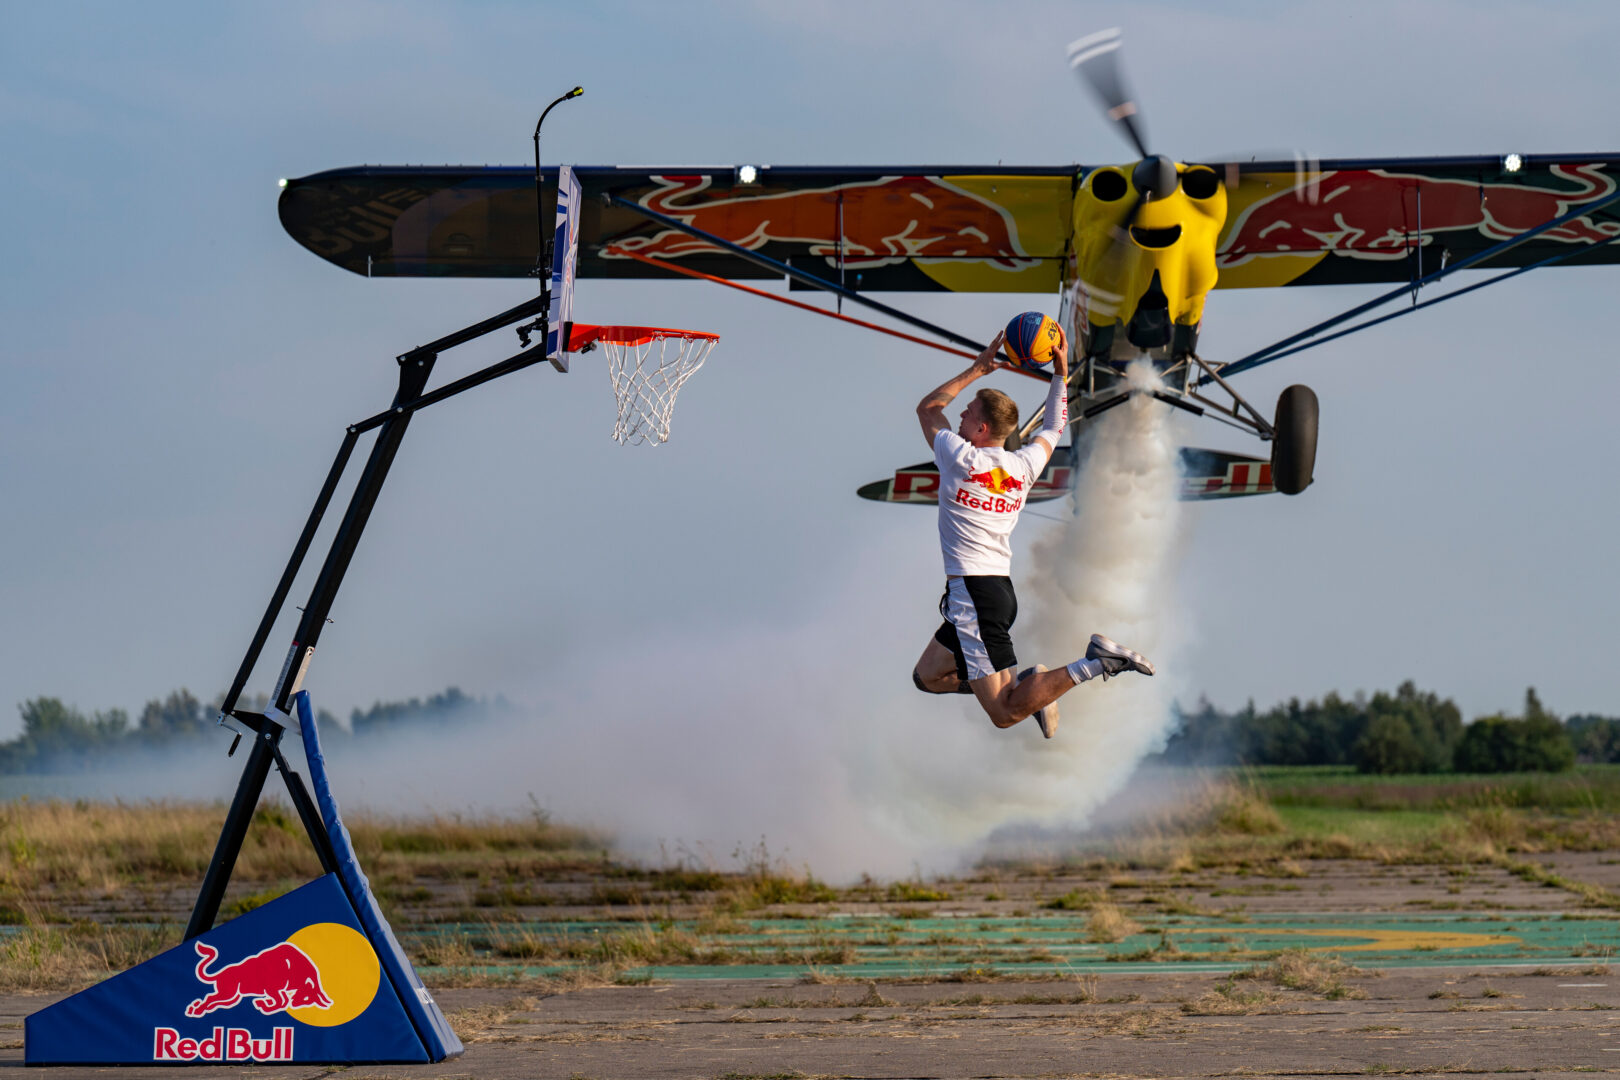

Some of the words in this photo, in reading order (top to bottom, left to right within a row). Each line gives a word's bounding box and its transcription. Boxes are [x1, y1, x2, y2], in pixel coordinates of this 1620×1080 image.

[956, 488, 994, 511] Red
[995, 497, 1022, 513] Bull
[154, 1027, 224, 1060] Red
[227, 1027, 294, 1060] Bull
